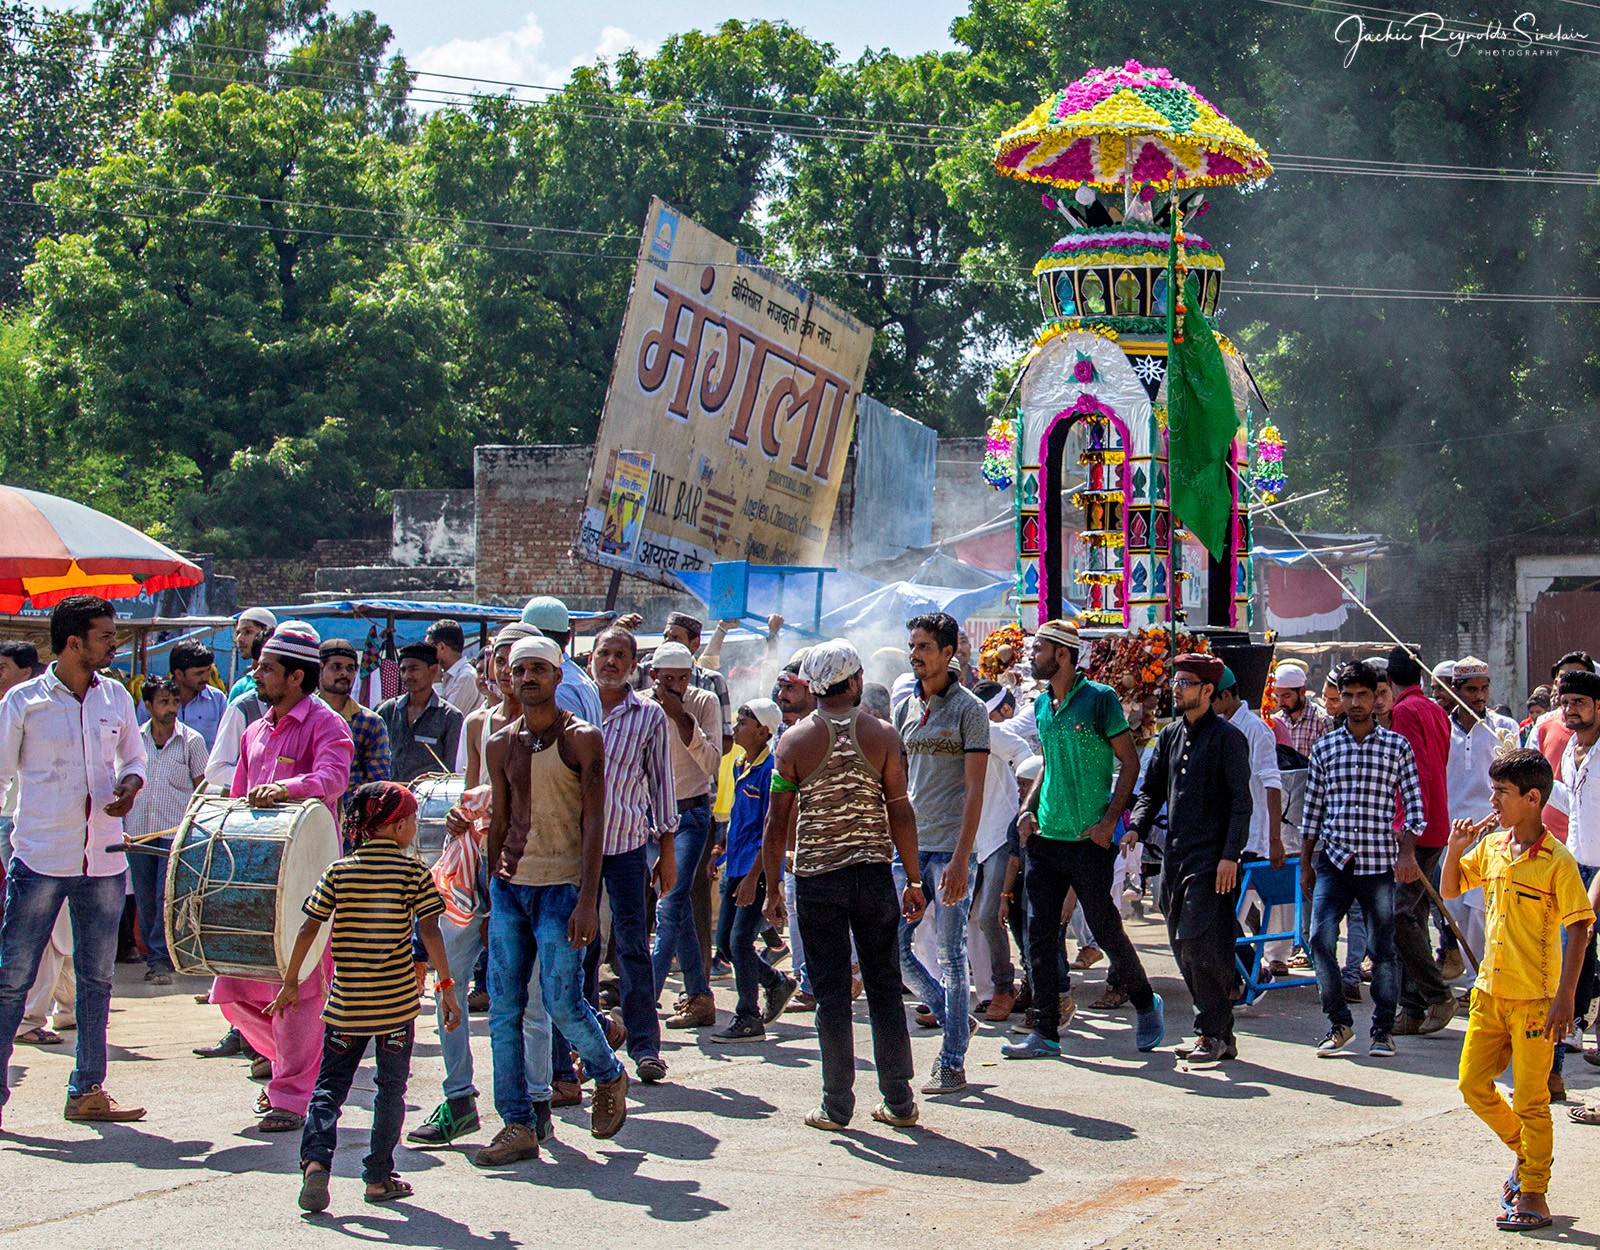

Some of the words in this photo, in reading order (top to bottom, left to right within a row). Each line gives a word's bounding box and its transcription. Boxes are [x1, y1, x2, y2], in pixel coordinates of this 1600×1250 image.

[731, 275, 764, 313] बेमिसाल
[766, 307, 800, 335] मजबूती
[800, 319, 816, 340] का
[638, 265, 851, 480] मंगला
[673, 480, 703, 527] BAR
[639, 541, 679, 570] आयरन
